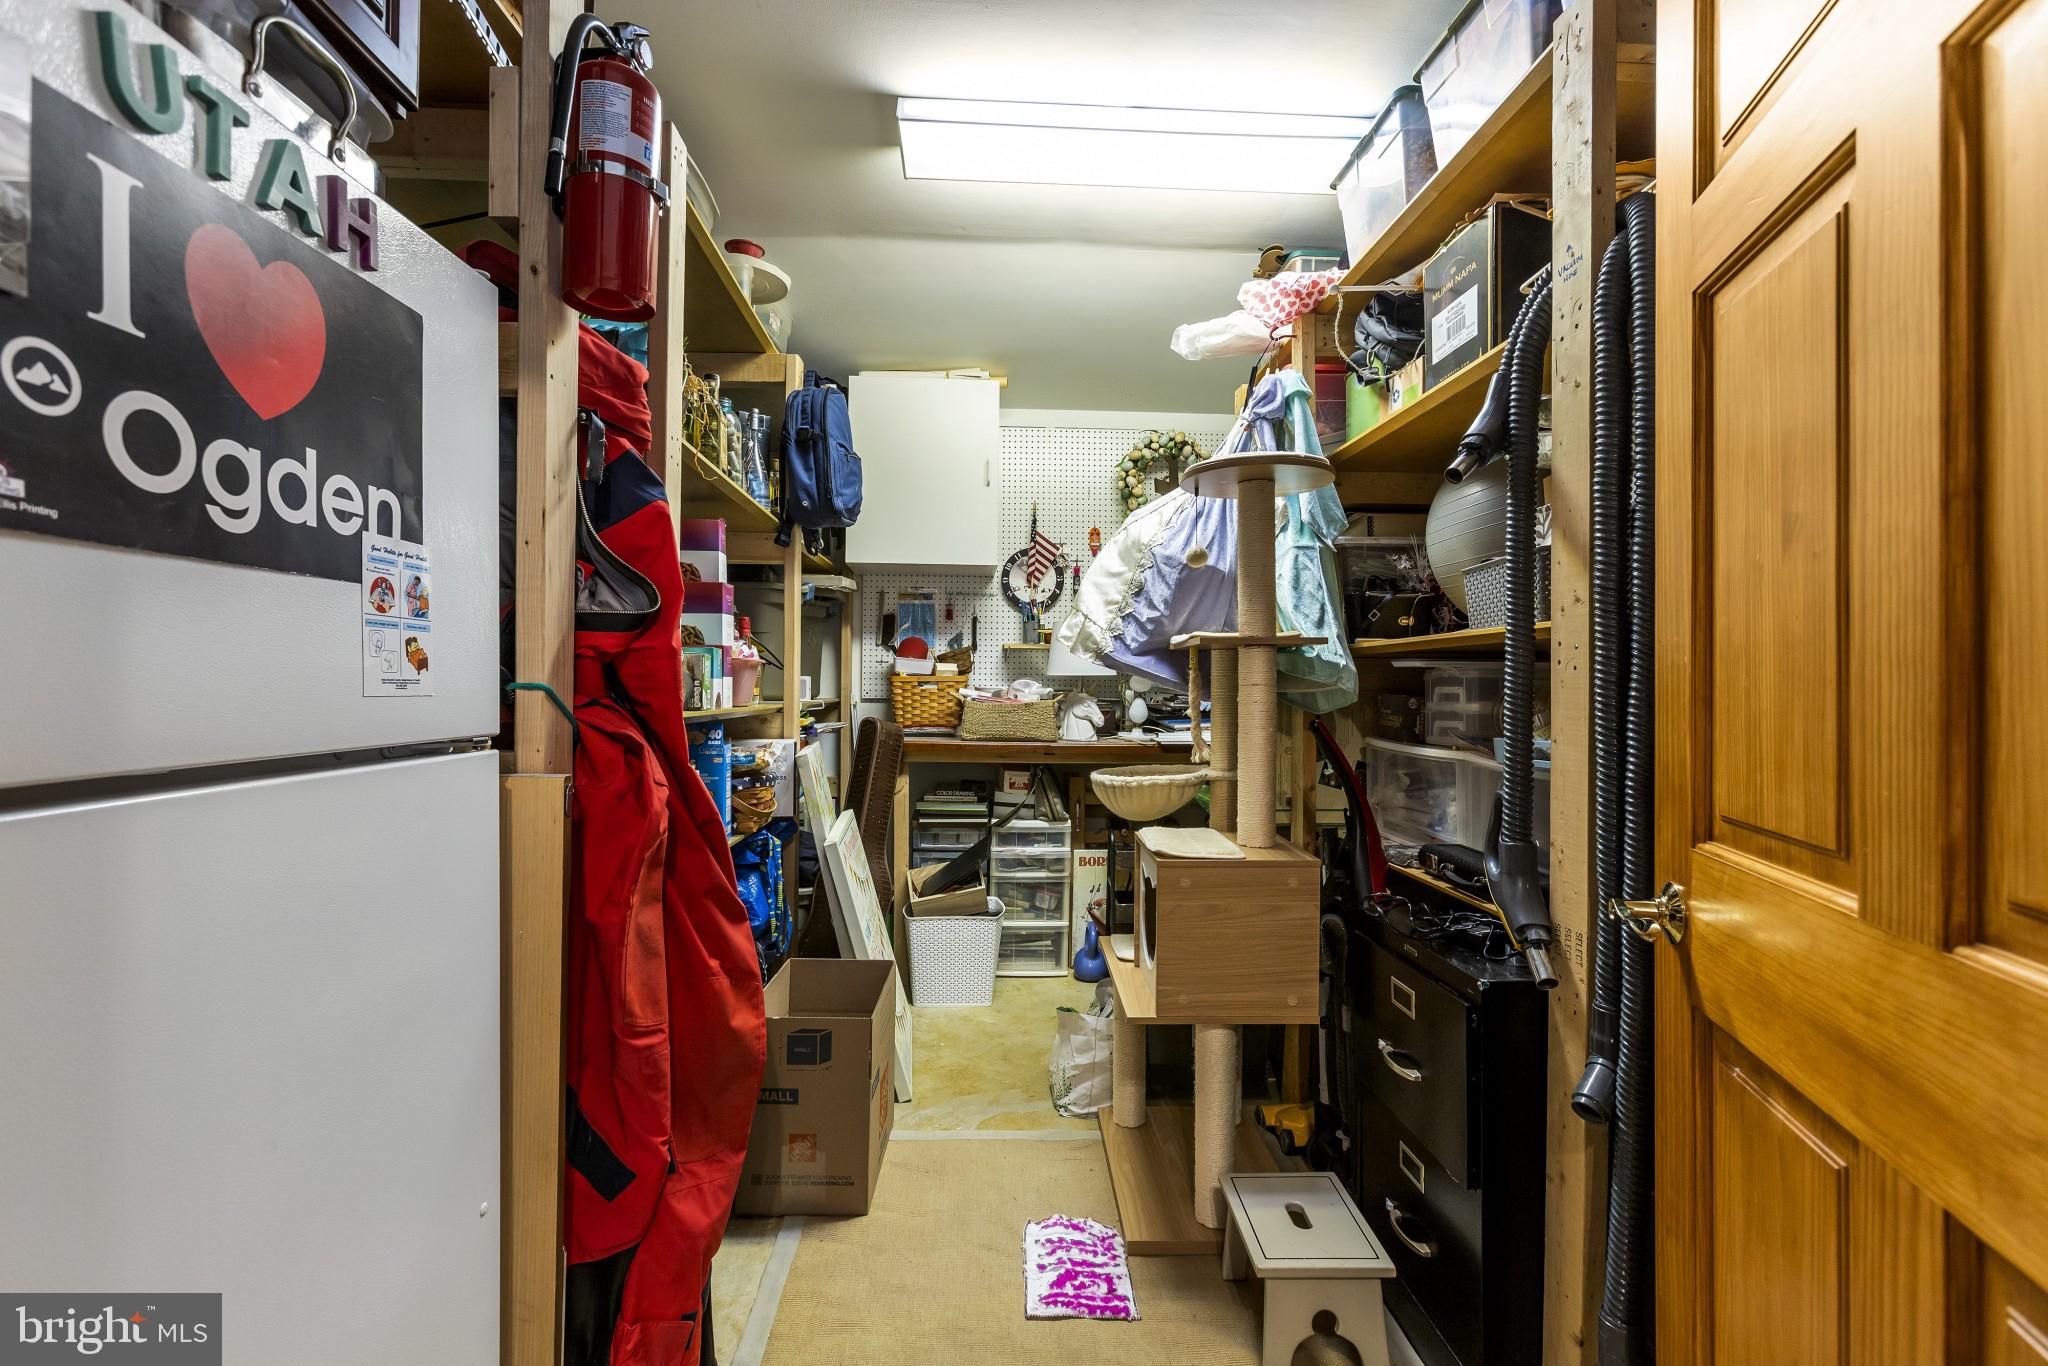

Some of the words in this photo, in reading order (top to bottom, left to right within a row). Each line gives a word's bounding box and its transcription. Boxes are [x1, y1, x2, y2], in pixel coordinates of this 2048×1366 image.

[96, 10, 379, 271] UTAH
[86, 152, 146, 338] I
[1558, 254, 1584, 277] VACUUM
[1432, 279, 1454, 303] MUMM
[1454, 261, 1477, 285] NAPA
[103, 390, 401, 539] Ogden
[708, 729, 722, 740] 40
[1079, 856, 1108, 867] BOR
[760, 1091, 793, 1101] MALL
